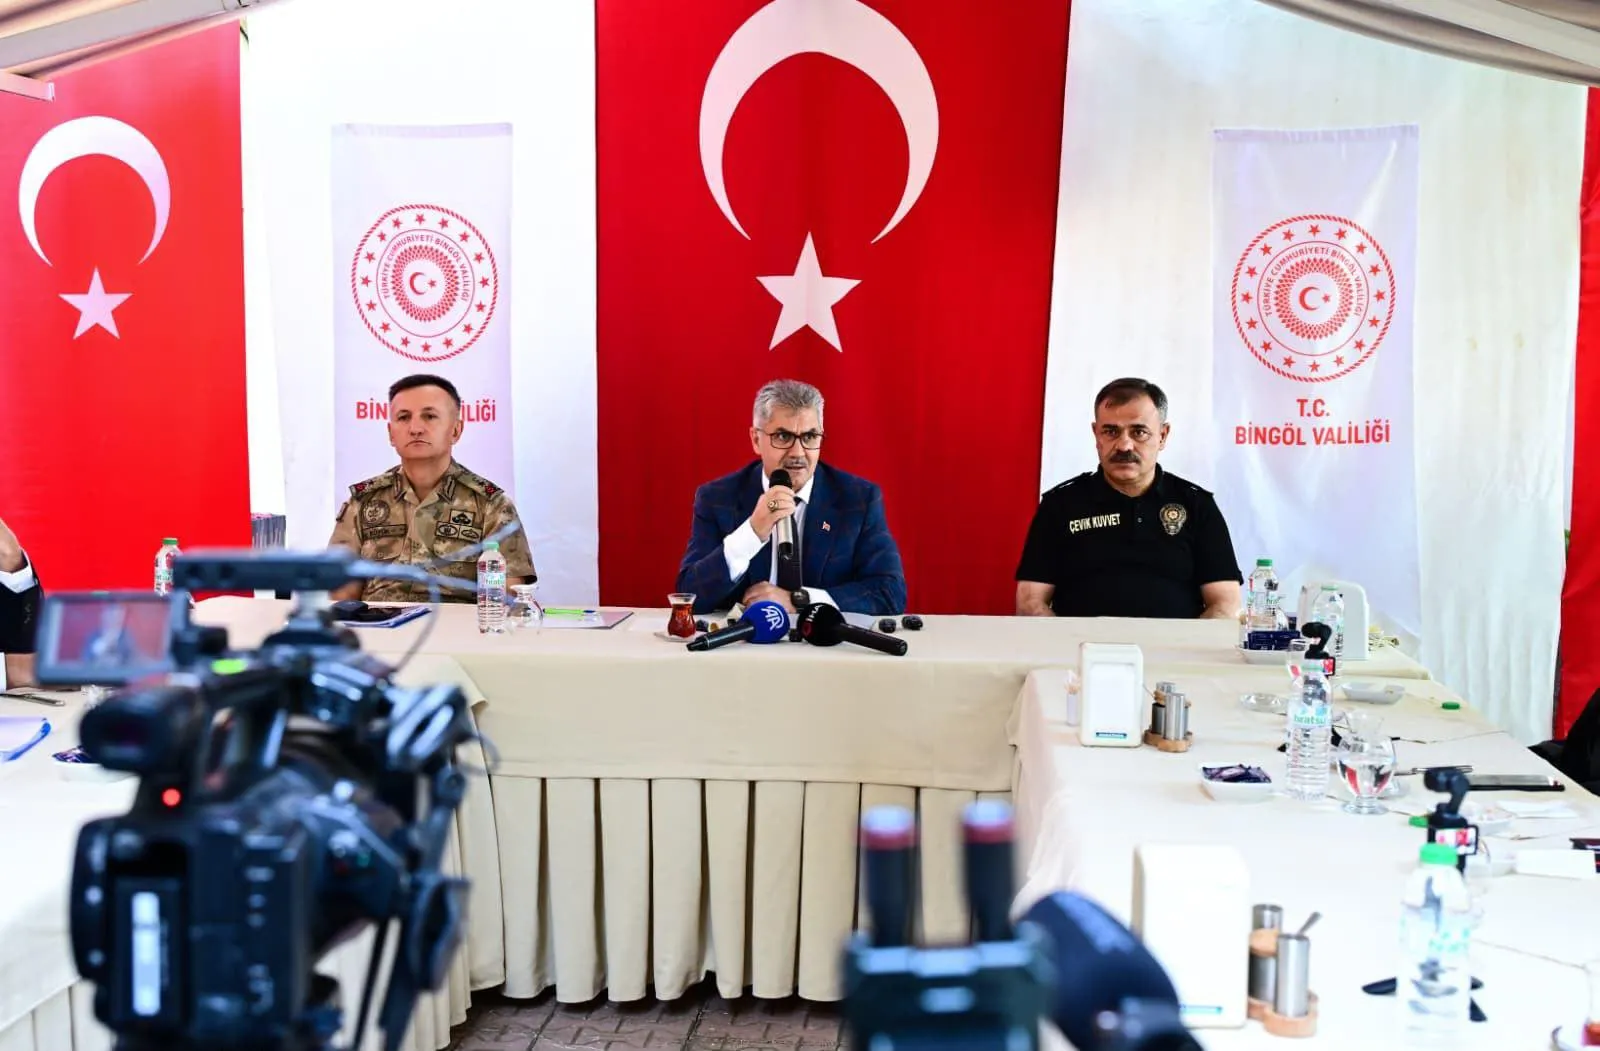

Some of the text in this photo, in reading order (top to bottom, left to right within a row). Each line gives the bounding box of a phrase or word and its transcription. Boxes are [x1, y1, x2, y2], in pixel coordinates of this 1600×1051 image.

[381, 262, 391, 299] TÜRKİYE
[387, 233, 434, 261] CUMHURİYETİ
[434, 237, 461, 263] BİNGÖL
[1263, 277, 1274, 317] TÜRKİYE
[1270, 246, 1330, 276] CUMHURİYETİ
[1330, 249, 1357, 276] BİNGÖL
[356, 397, 388, 420] BİN
[1296, 398, 1330, 418] T.C.
[1234, 418, 1391, 446] BİNGÖL VALİLİĞİ
[1091, 512, 1121, 529] KUVVET
